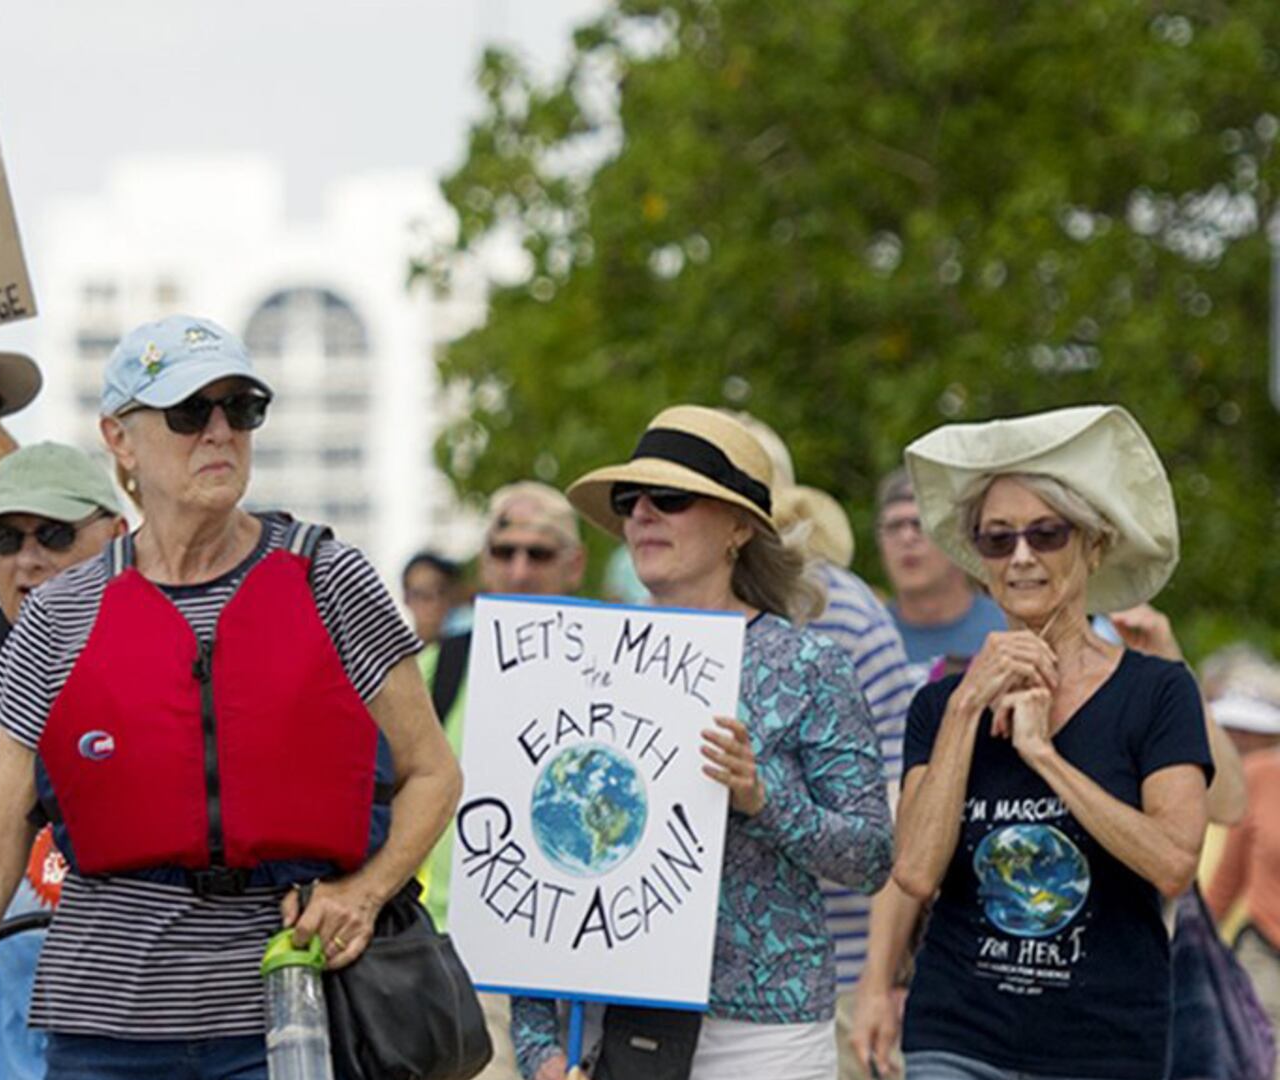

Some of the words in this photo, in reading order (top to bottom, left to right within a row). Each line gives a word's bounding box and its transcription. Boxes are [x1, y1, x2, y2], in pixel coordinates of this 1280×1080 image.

[493, 611, 586, 673] LET'S
[612, 618, 725, 707] MAKE
[516, 703, 679, 781] EARTH
[456, 797, 576, 943] GREAT
[571, 803, 704, 950] AGAIN!
